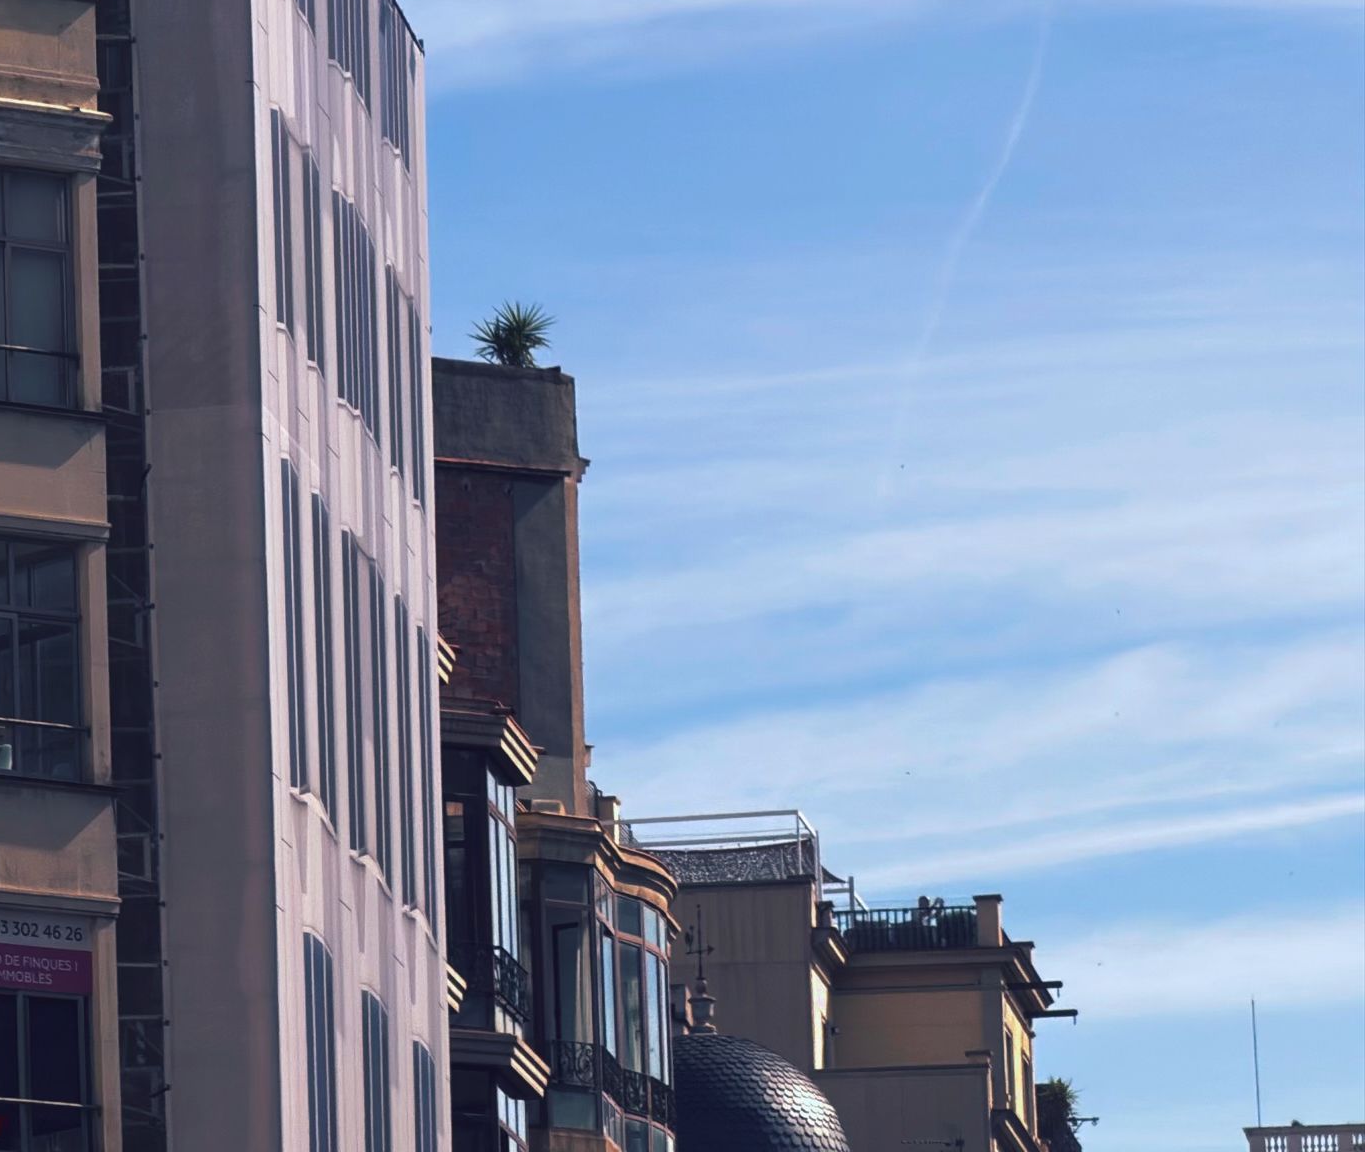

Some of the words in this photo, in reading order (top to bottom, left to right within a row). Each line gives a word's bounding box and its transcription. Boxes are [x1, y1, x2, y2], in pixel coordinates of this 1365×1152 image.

[12, 921, 39, 938] 302
[43, 925, 61, 940] 46
[65, 926, 83, 942] 26
[5, 954, 21, 967] DE
[22, 956, 72, 971] FINQUES
